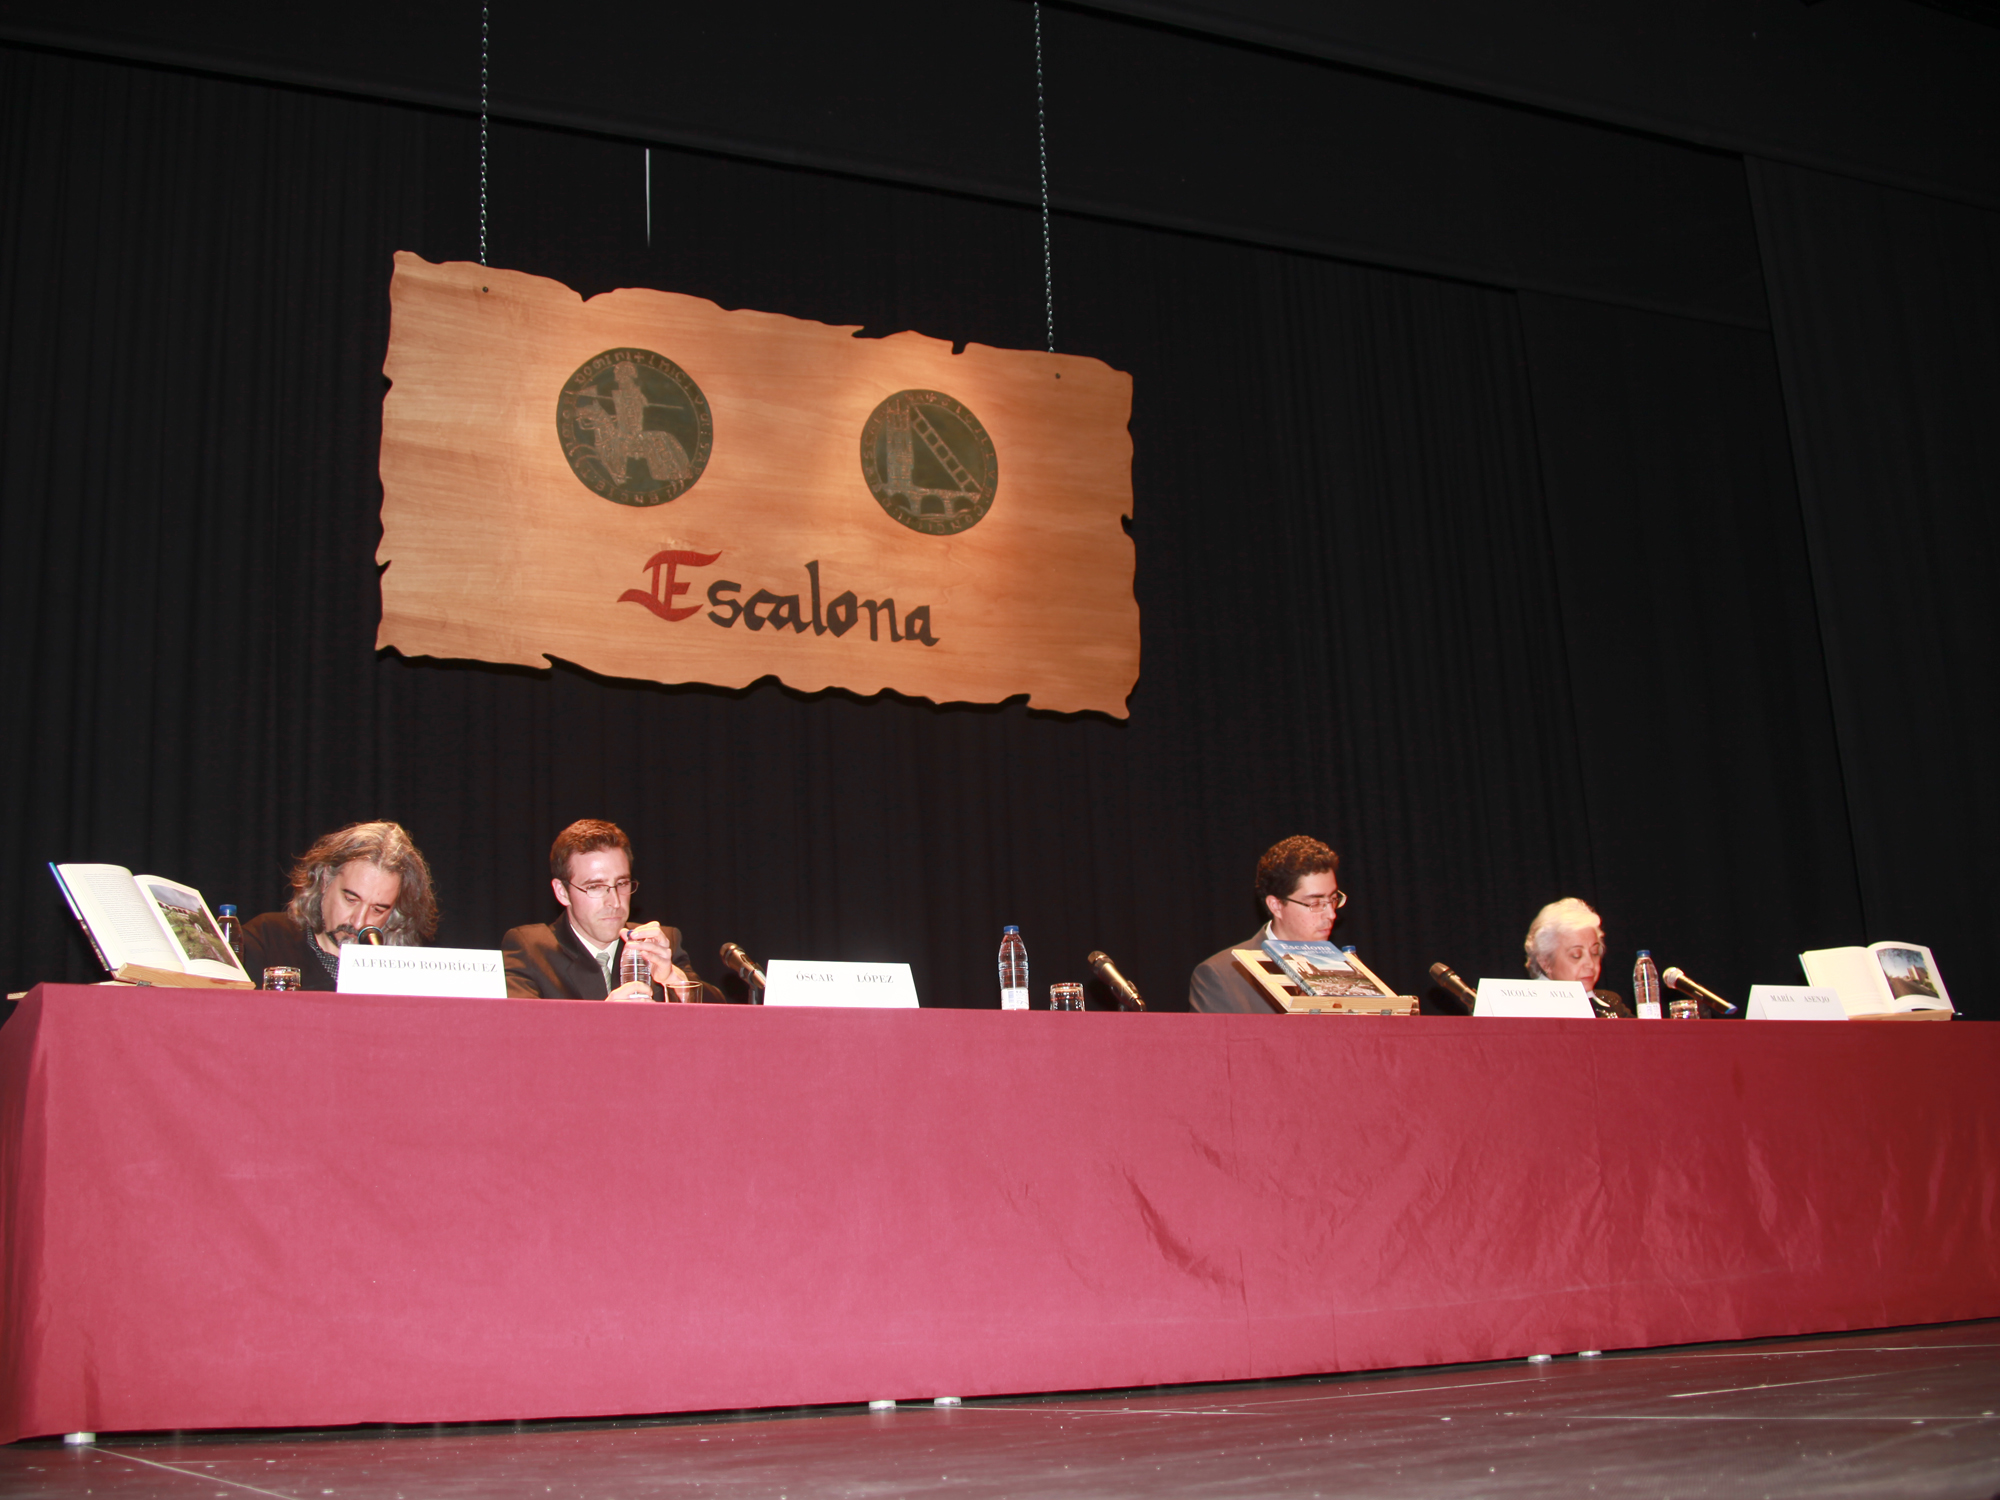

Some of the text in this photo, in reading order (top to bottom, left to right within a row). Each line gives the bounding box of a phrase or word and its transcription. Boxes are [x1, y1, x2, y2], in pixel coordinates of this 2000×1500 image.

[616, 550, 941, 647] Escalona
[352, 958, 498, 973] ALFREDO RODRÍGUEZ
[796, 971, 894, 984] ÓSCAR LÓPEZ
